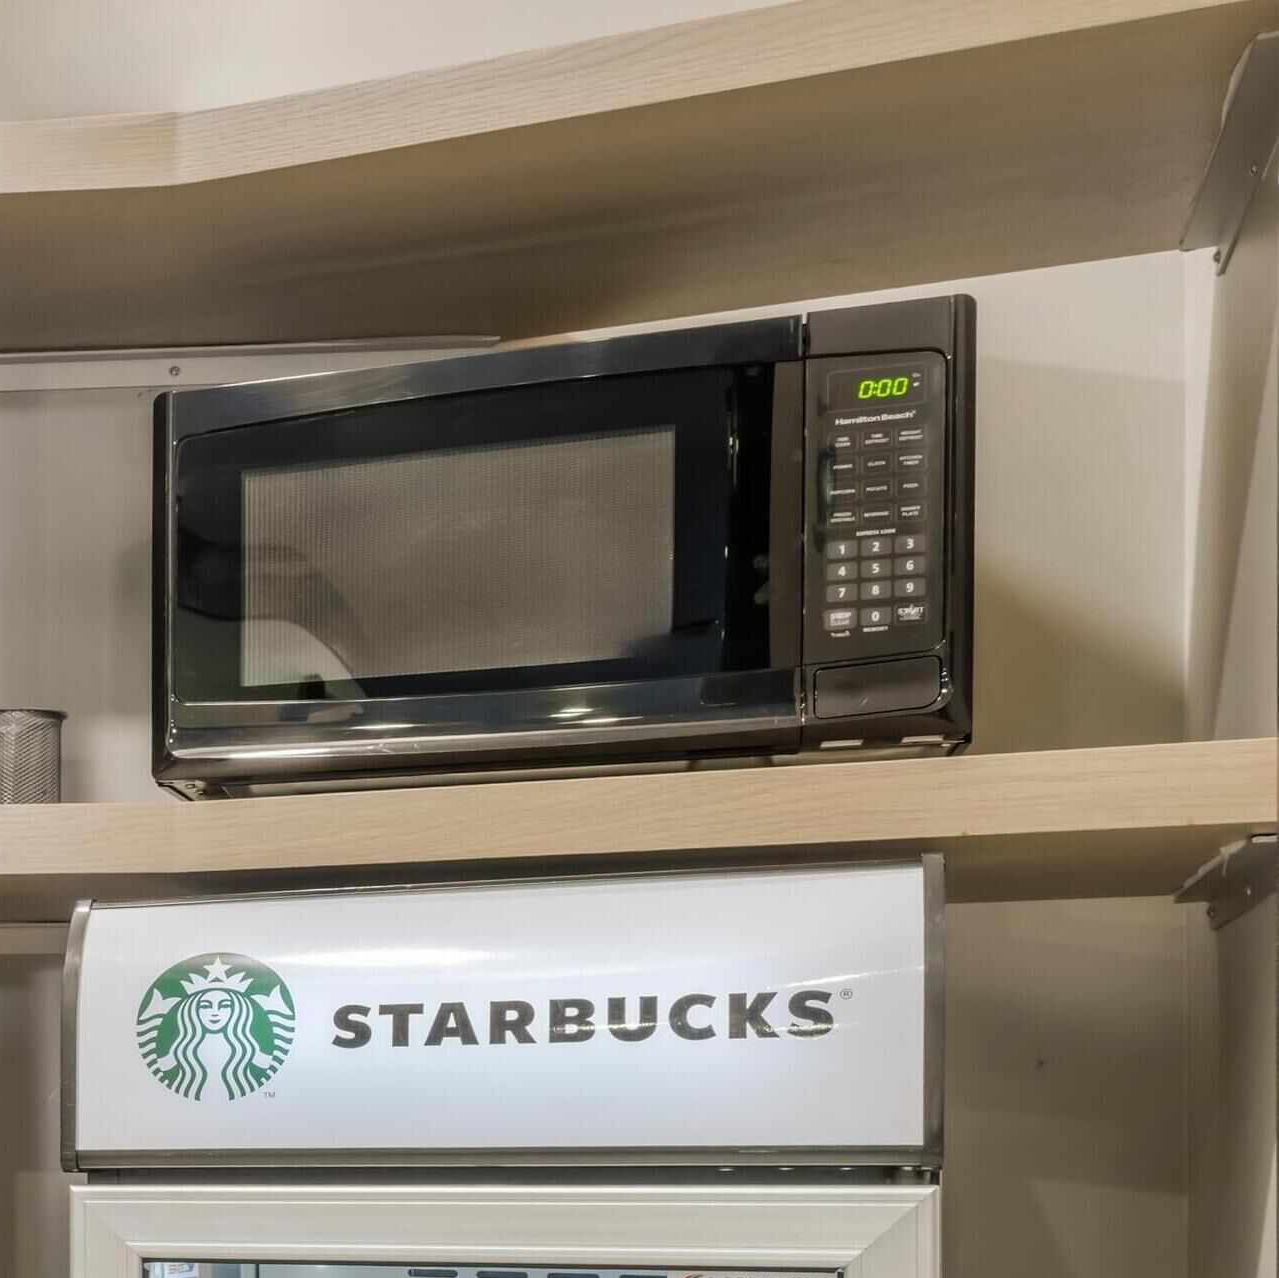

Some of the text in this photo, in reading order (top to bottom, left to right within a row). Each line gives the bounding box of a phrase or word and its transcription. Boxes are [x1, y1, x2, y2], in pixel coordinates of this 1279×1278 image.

[857, 376, 909, 400] 0:00
[835, 412, 913, 425] Hamilton Beach
[872, 541, 880, 552] 2
[906, 538, 914, 549] 3
[839, 544, 845, 555] 1
[838, 566, 846, 576] 4
[872, 563, 880, 573] 5
[906, 560, 914, 571] 6
[838, 587, 846, 598] 7
[872, 585, 880, 595] 8
[906, 582, 914, 593] 9
[871, 611, 880, 622] 0
[331, 989, 837, 1050] STARBUCKS
